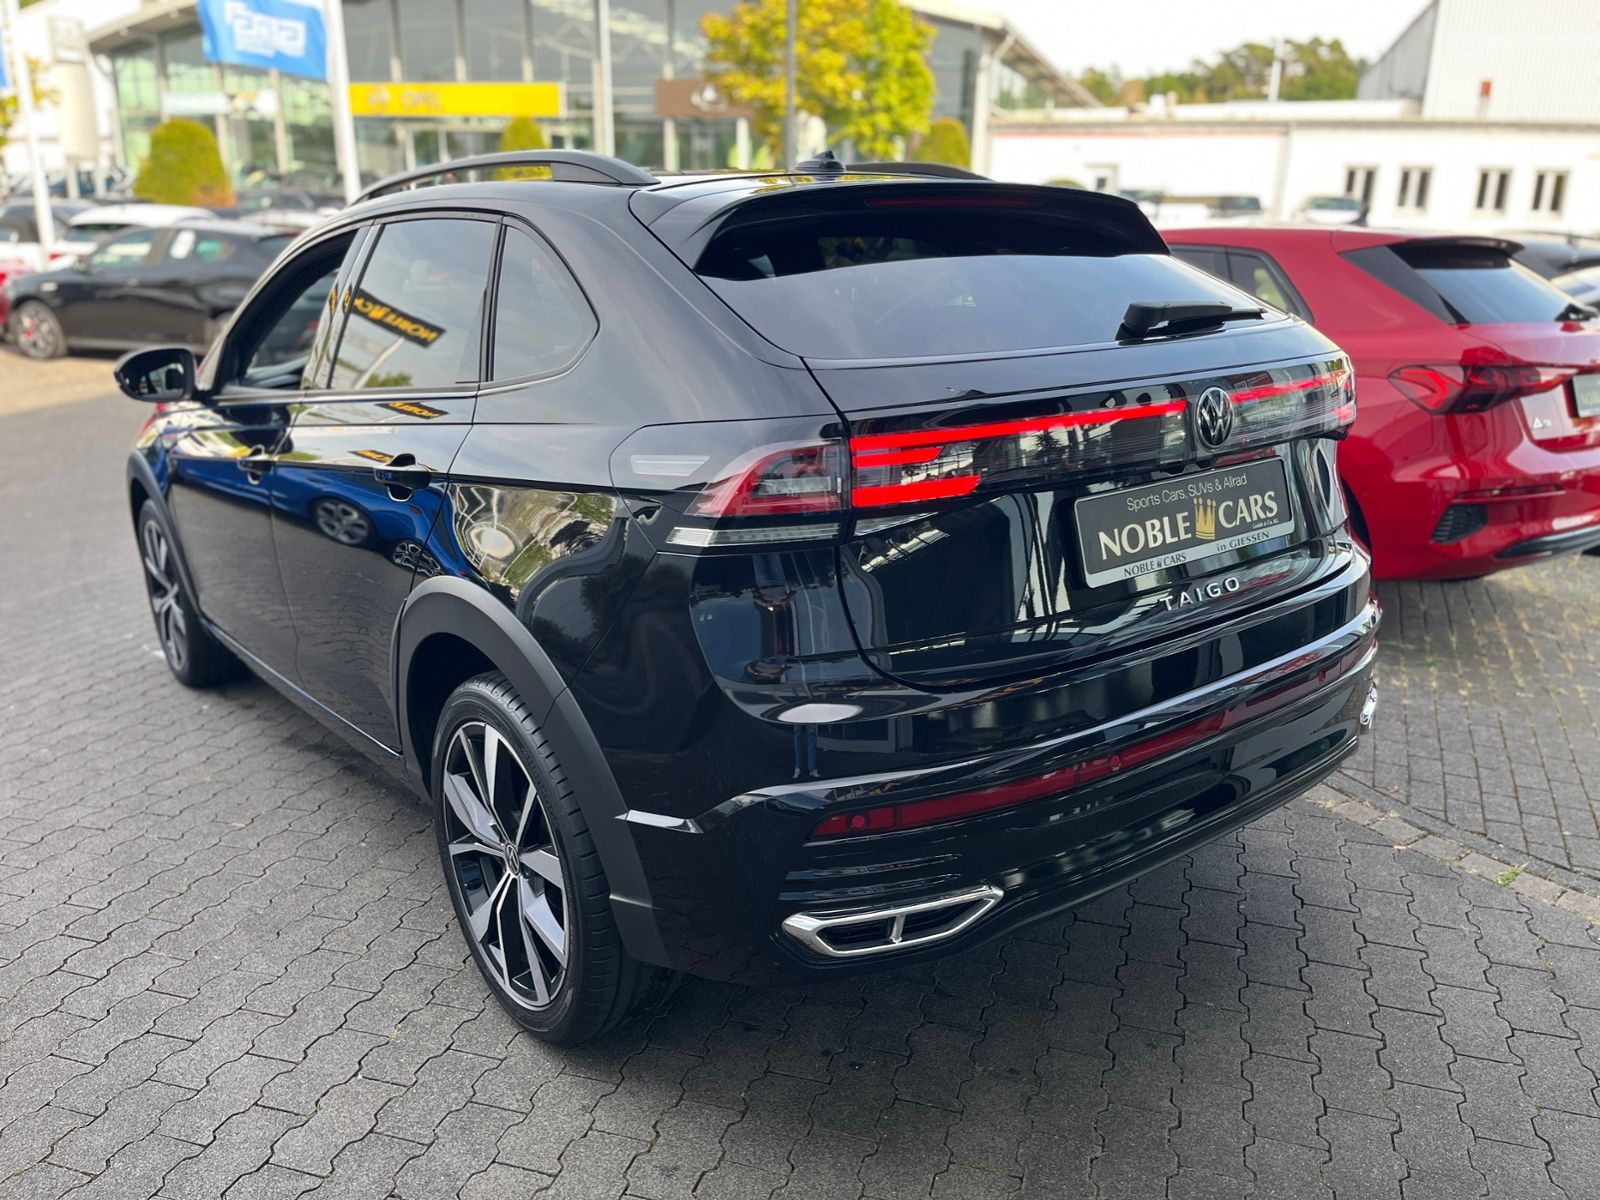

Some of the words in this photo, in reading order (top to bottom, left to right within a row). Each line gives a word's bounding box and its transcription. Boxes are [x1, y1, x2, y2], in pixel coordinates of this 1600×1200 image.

[1126, 494, 1161, 512] Sports
[1161, 489, 1188, 503] Cars,
[1187, 482, 1214, 497] SUVs
[1215, 478, 1222, 491] &
[1223, 473, 1248, 489] Allrad
[1098, 511, 1192, 560] NOBLE
[1218, 490, 1278, 528] CARS
[1123, 560, 1155, 577] NOBLE
[1163, 552, 1187, 567] CARS
[1216, 543, 1227, 552] in
[1229, 531, 1270, 550] GIESSEN
[1159, 577, 1240, 611] TAIGO
